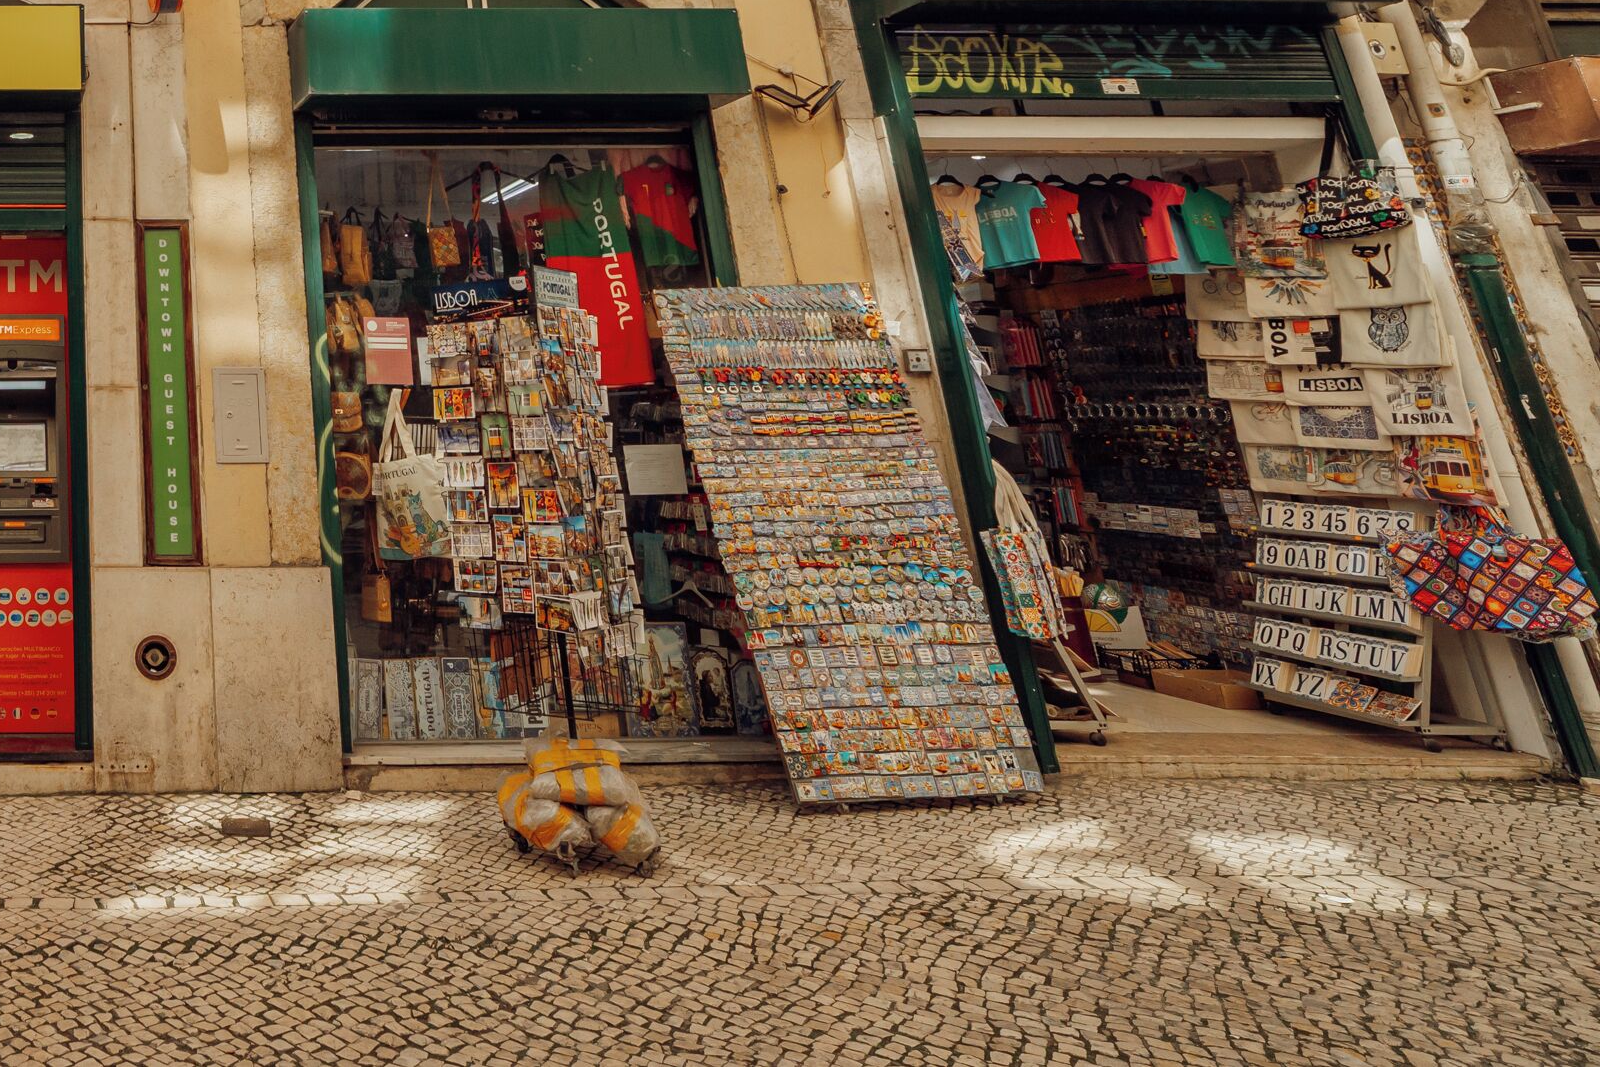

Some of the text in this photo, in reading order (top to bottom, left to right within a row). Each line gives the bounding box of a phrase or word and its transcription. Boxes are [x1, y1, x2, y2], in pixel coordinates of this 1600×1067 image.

[1255, 198, 1297, 211] Portugal
[593, 197, 634, 330] PORTUGAL
[158, 239, 173, 353] DOWNTOWN
[434, 288, 478, 310] LISBOA
[542, 281, 572, 296] PORTUGAL
[1268, 318, 1288, 358] BOA
[1299, 378, 1362, 391] LISBOA
[164, 373, 175, 446] GUEST
[1391, 412, 1454, 425] LISBOA
[167, 468, 179, 543] HOUSE
[1281, 508, 1295, 528] 2
[1302, 510, 1314, 530] 3
[1357, 515, 1370, 535] 6
[1266, 545, 1278, 564] 9
[1336, 552, 1349, 573] C
[1352, 553, 1366, 574] D
[1315, 590, 1327, 610] J
[1329, 591, 1344, 613] K
[1354, 596, 1368, 617] L
[1368, 597, 1385, 620] M
[1391, 600, 1407, 624] N
[1276, 628, 1289, 648] P
[1292, 632, 1305, 653] Q
[1319, 635, 1333, 657] R
[1333, 640, 1350, 661] S
[1353, 643, 1367, 665] T
[1369, 646, 1383, 668] U
[1391, 650, 1406, 672] V
[421, 667, 436, 733] PORTUGAL
[1295, 672, 1309, 693] Y
[1309, 675, 1324, 698] Z
